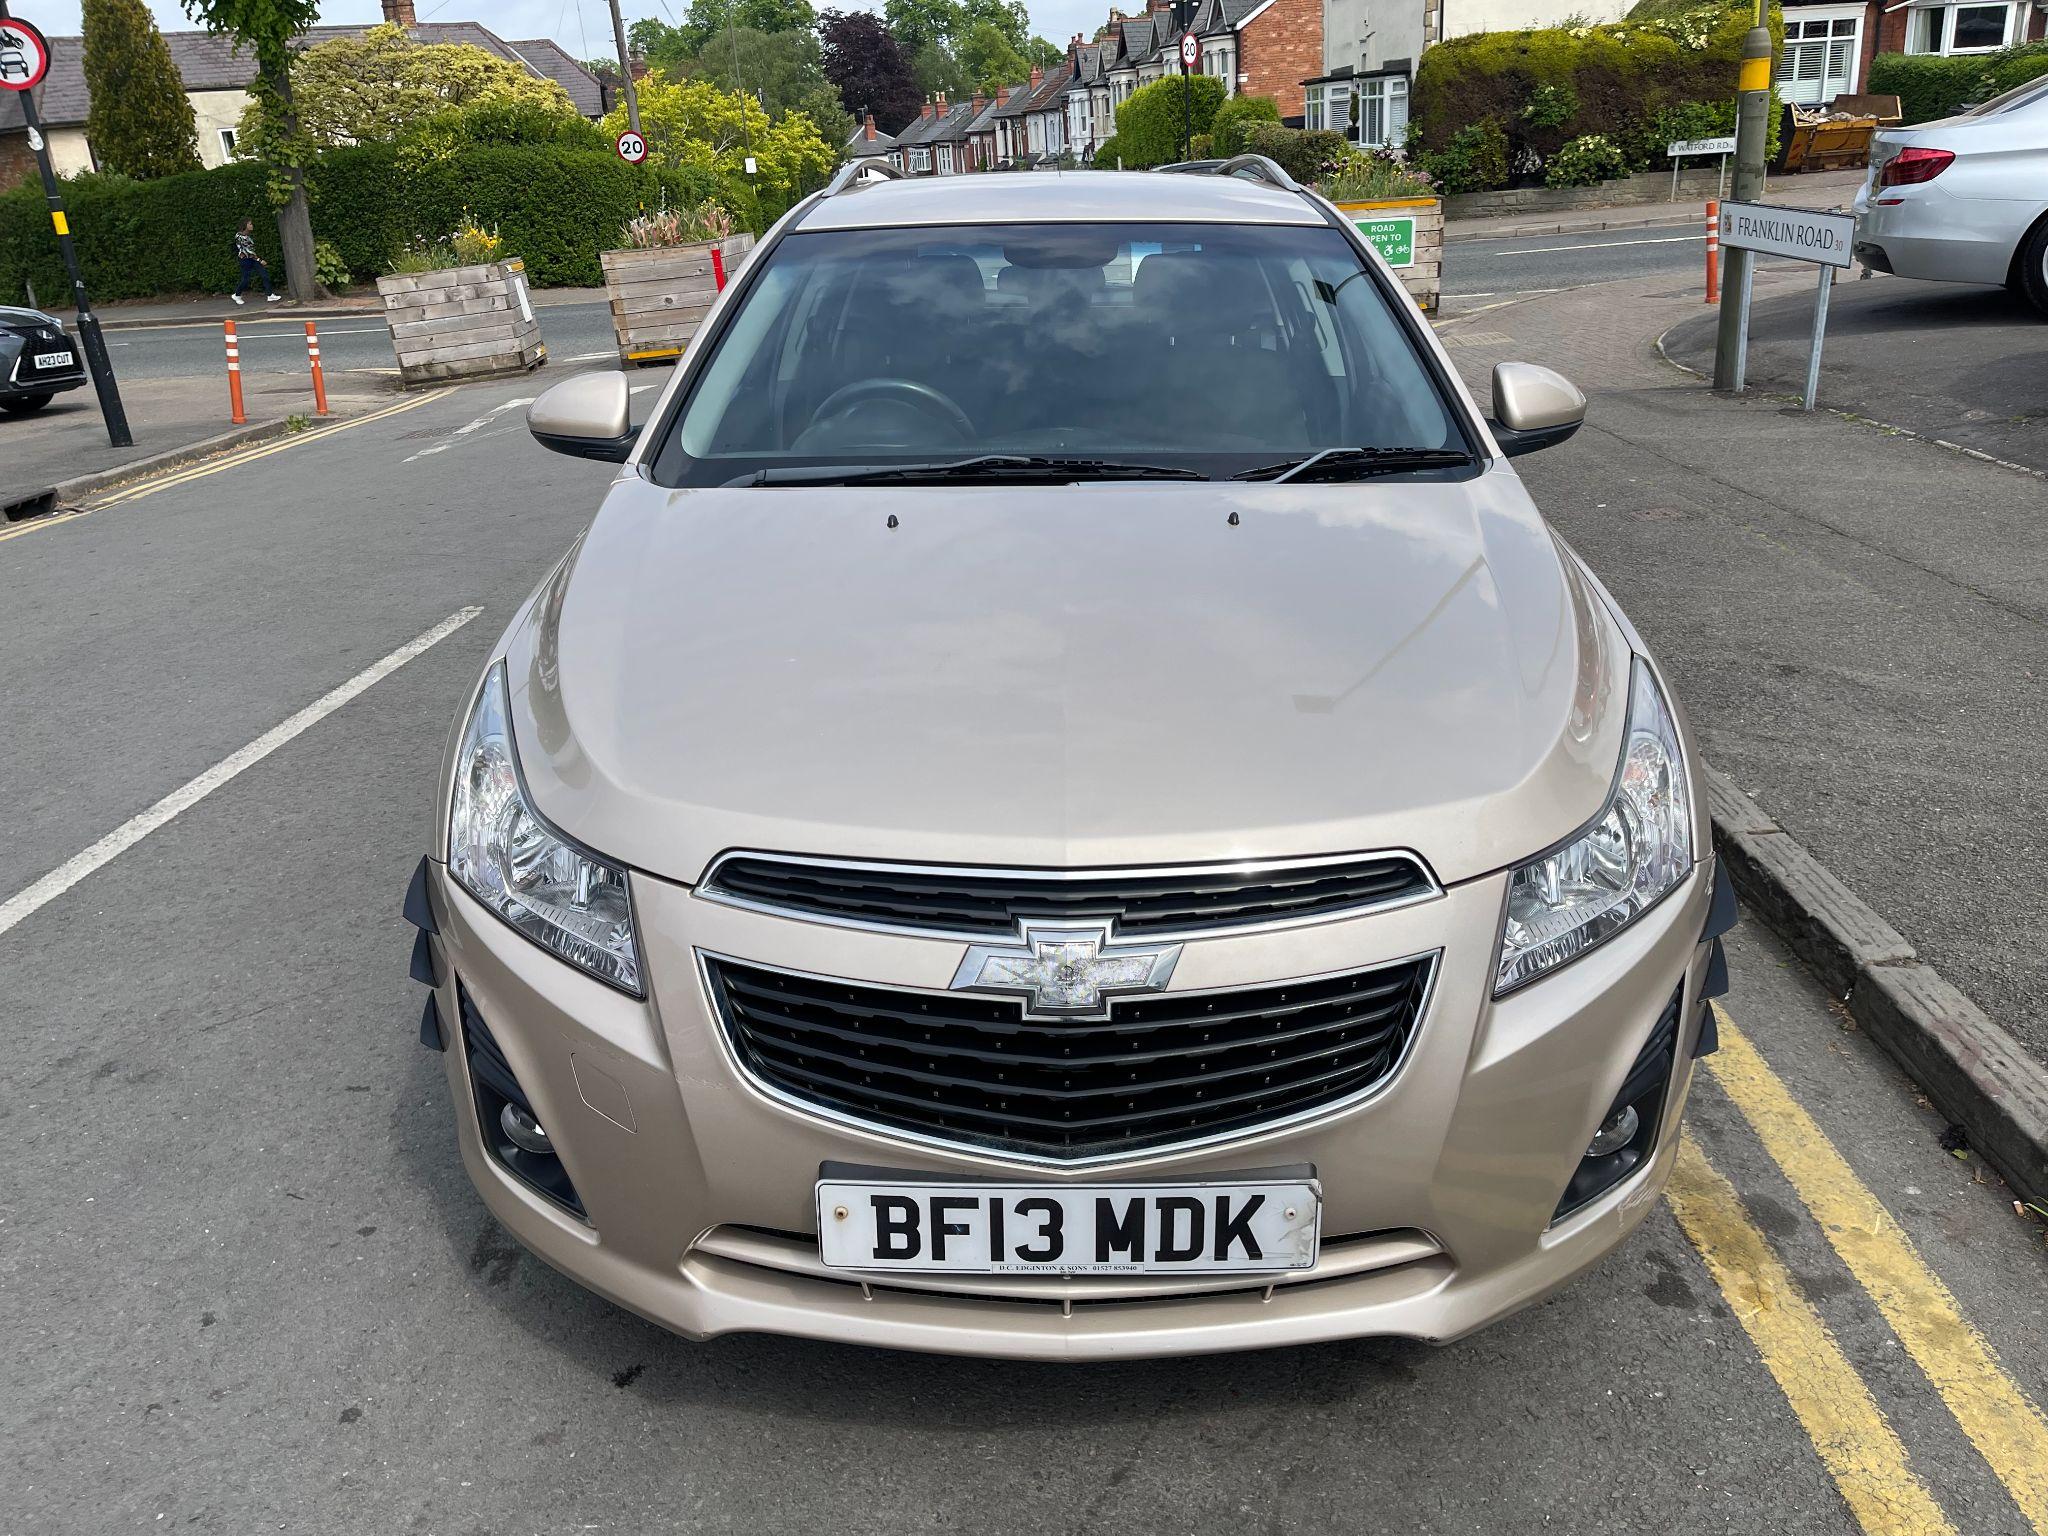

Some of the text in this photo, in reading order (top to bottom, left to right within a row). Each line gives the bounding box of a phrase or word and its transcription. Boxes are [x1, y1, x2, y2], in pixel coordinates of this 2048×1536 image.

[1184, 43, 1196, 56] 20
[621, 140, 643, 154] 20
[1678, 142, 1715, 152] WATFORD
[1716, 141, 1729, 149] RD
[1371, 225, 1396, 233] ROAD
[1738, 217, 1844, 252] FRANKLIN ROAD 30
[1390, 233, 1402, 242] TO
[56, 353, 70, 364] CUT
[870, 1194, 1266, 1262] BF13 MDK
